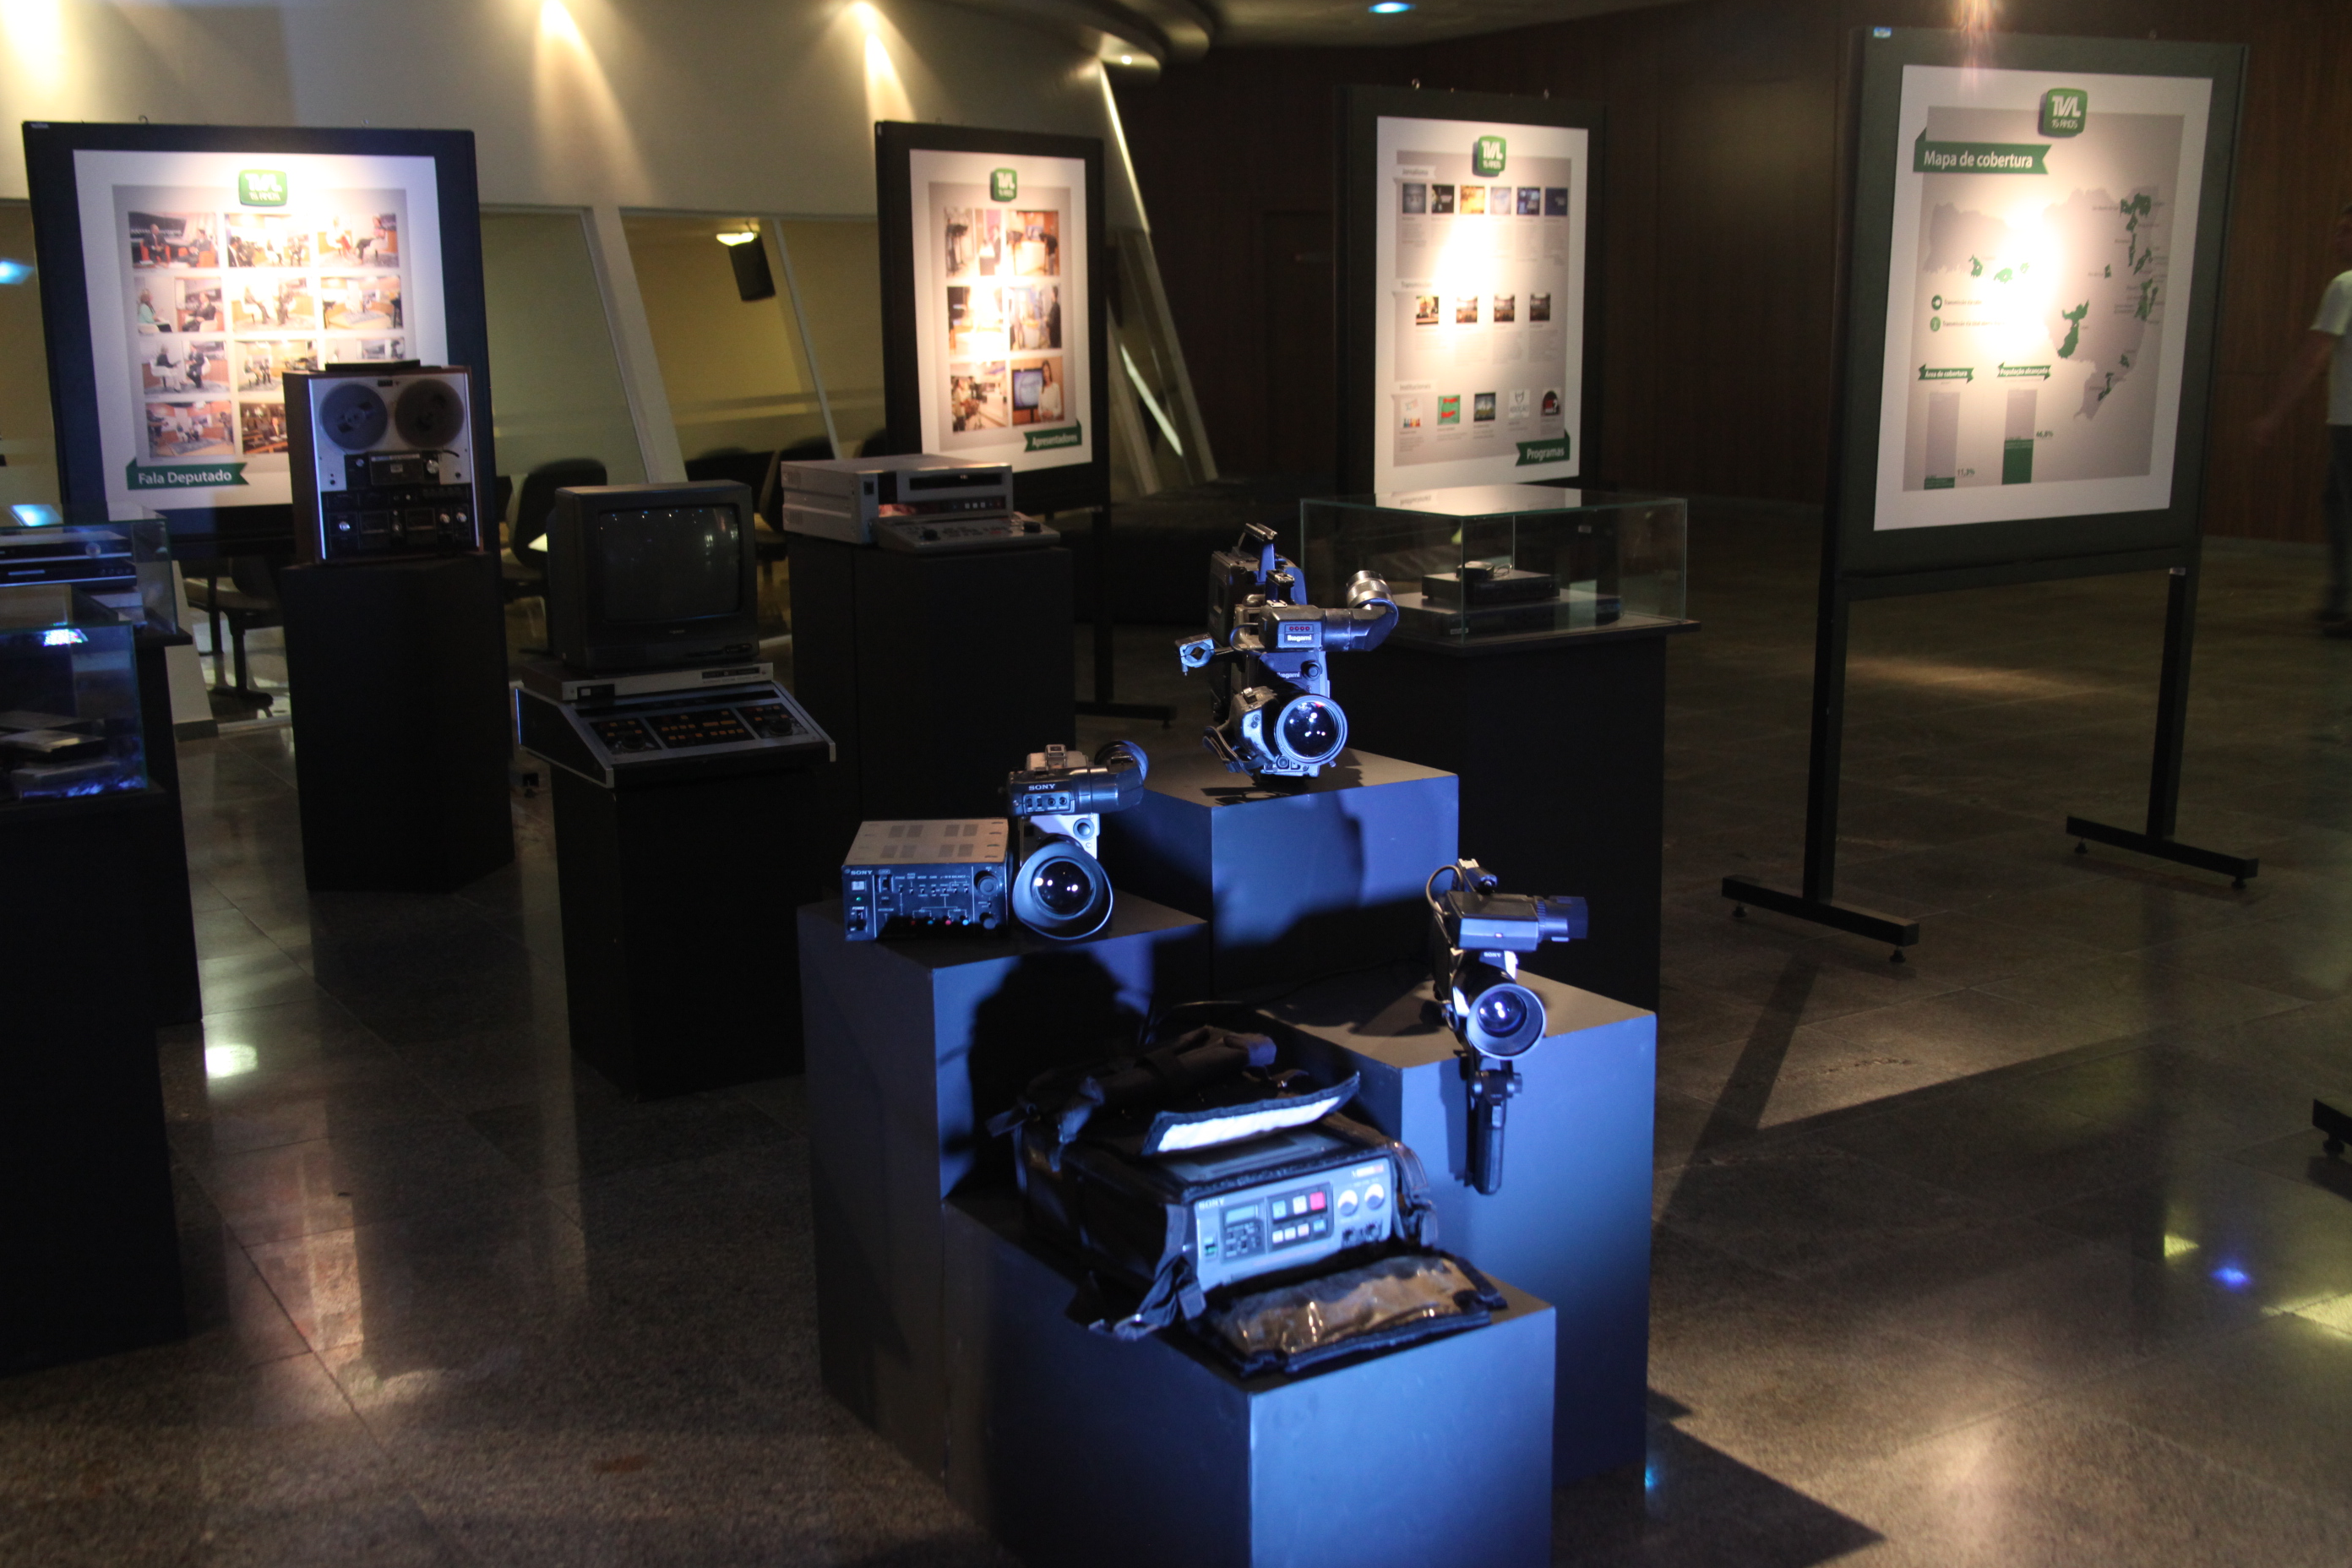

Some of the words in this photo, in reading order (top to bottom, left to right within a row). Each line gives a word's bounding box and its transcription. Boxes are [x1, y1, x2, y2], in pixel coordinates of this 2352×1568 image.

[1923, 150, 1957, 170] Mapa
[1959, 150, 1974, 166] de
[1977, 151, 2034, 168] cobertura
[1527, 447, 1565, 461] Programas
[138, 471, 165, 485] Fala
[167, 469, 232, 485] Deputado
[1198, 1196, 1224, 1210] SONY
